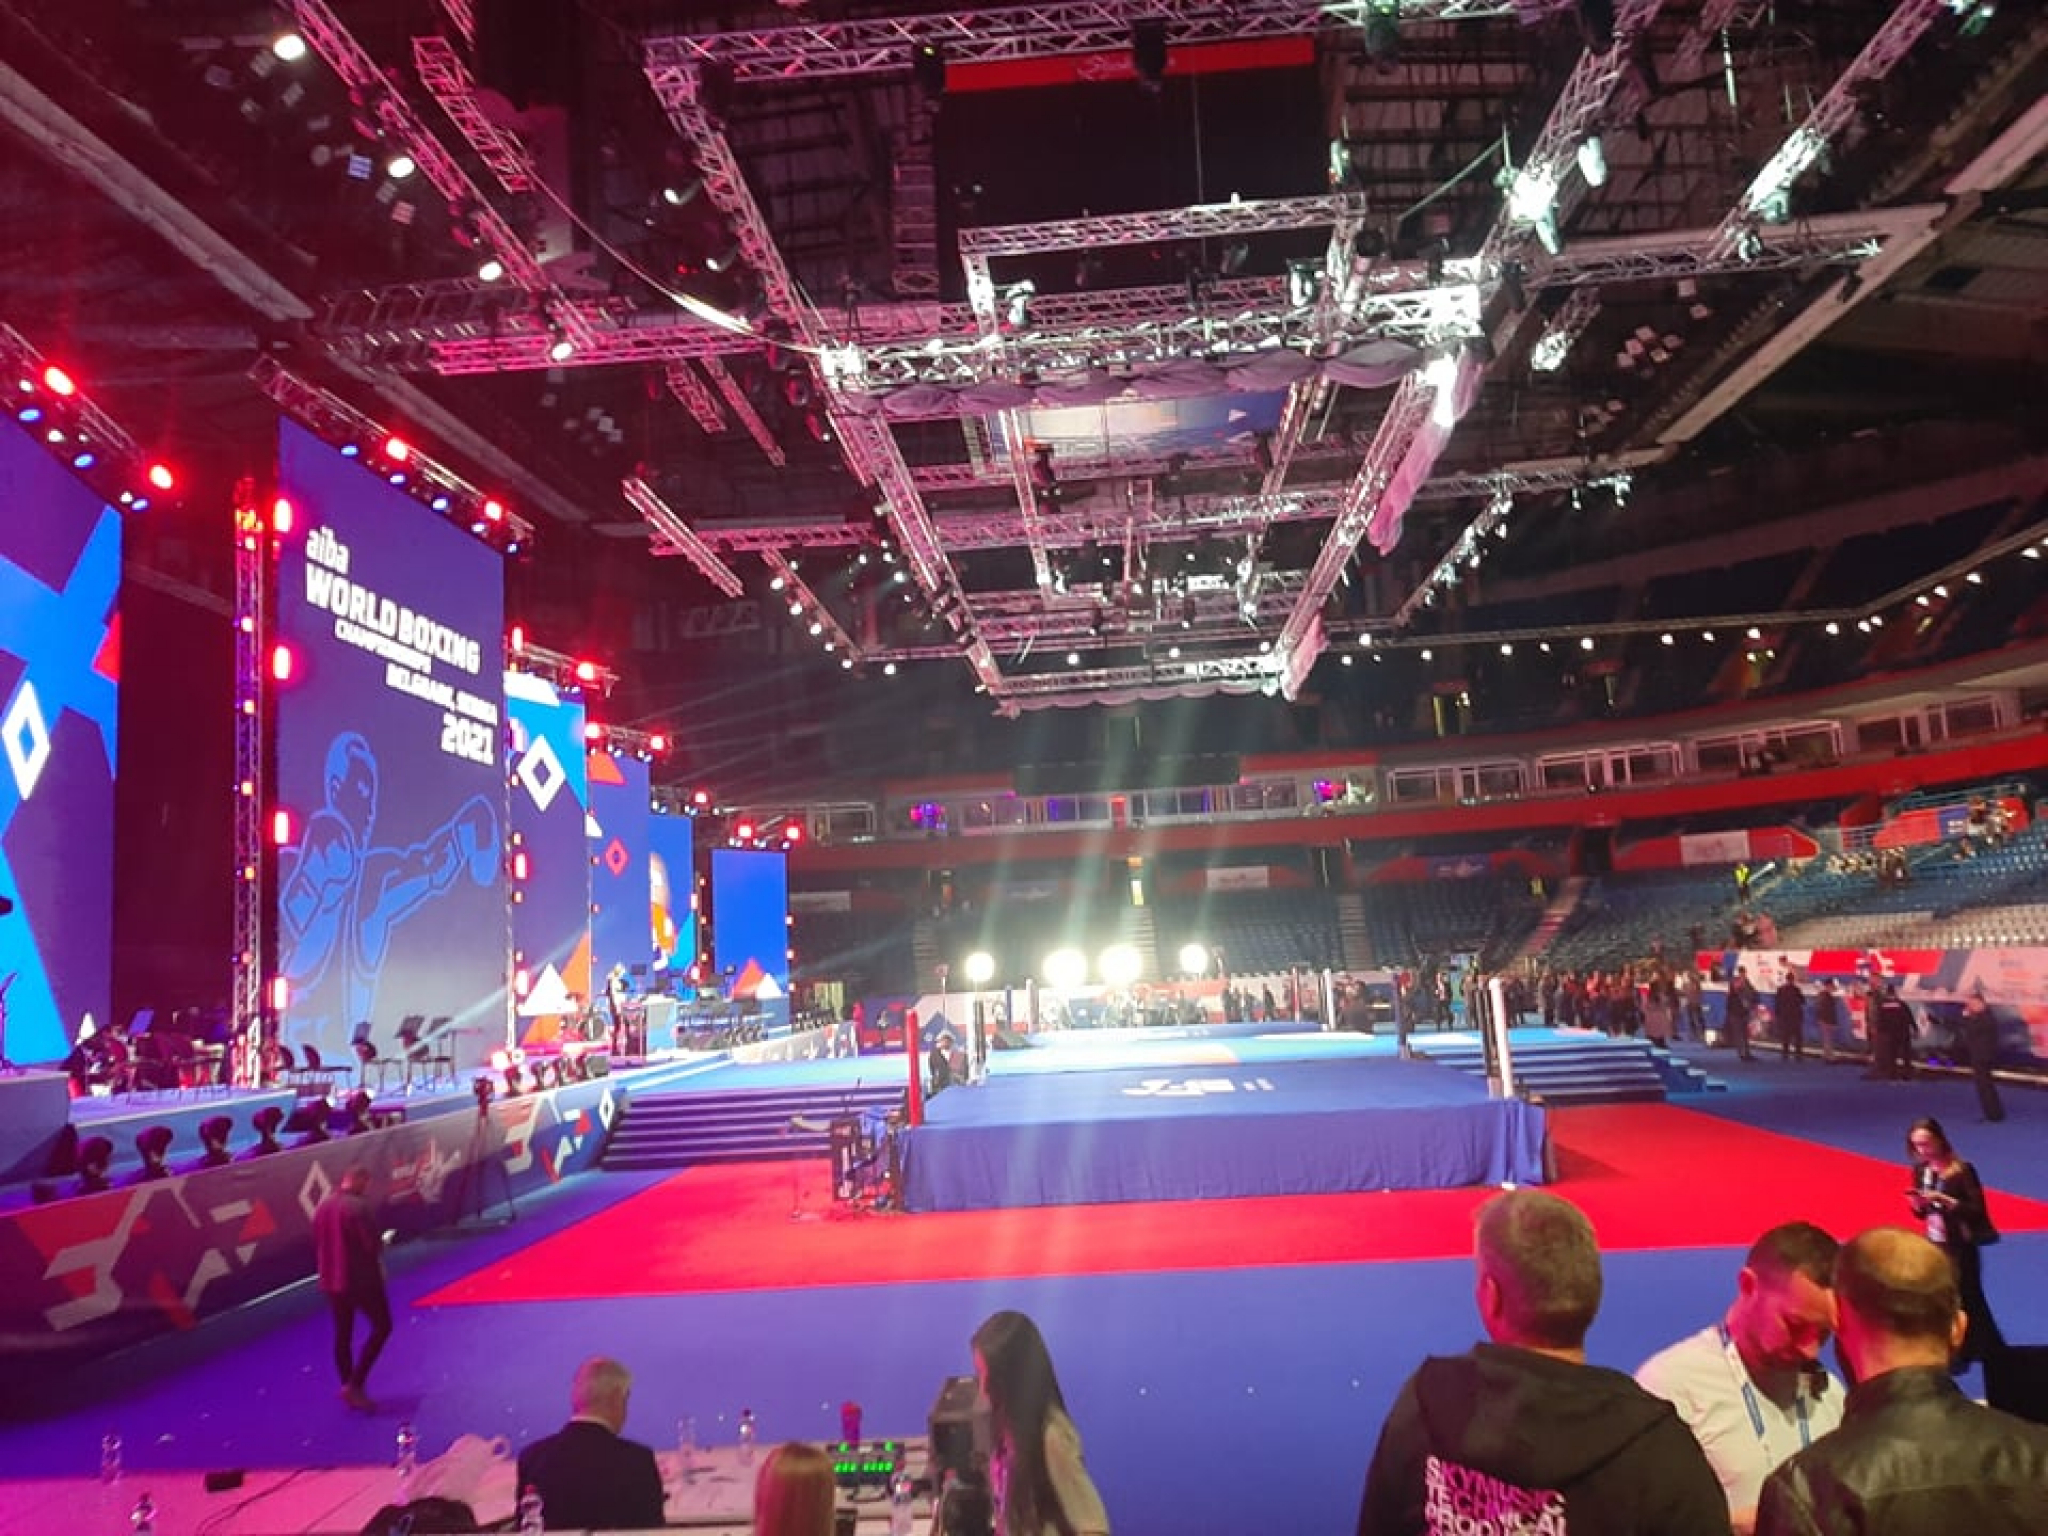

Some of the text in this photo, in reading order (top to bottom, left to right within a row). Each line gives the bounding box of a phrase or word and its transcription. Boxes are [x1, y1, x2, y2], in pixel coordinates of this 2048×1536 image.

[306, 563, 480, 675] WORLD BOXING
[440, 711, 495, 766] 2021
